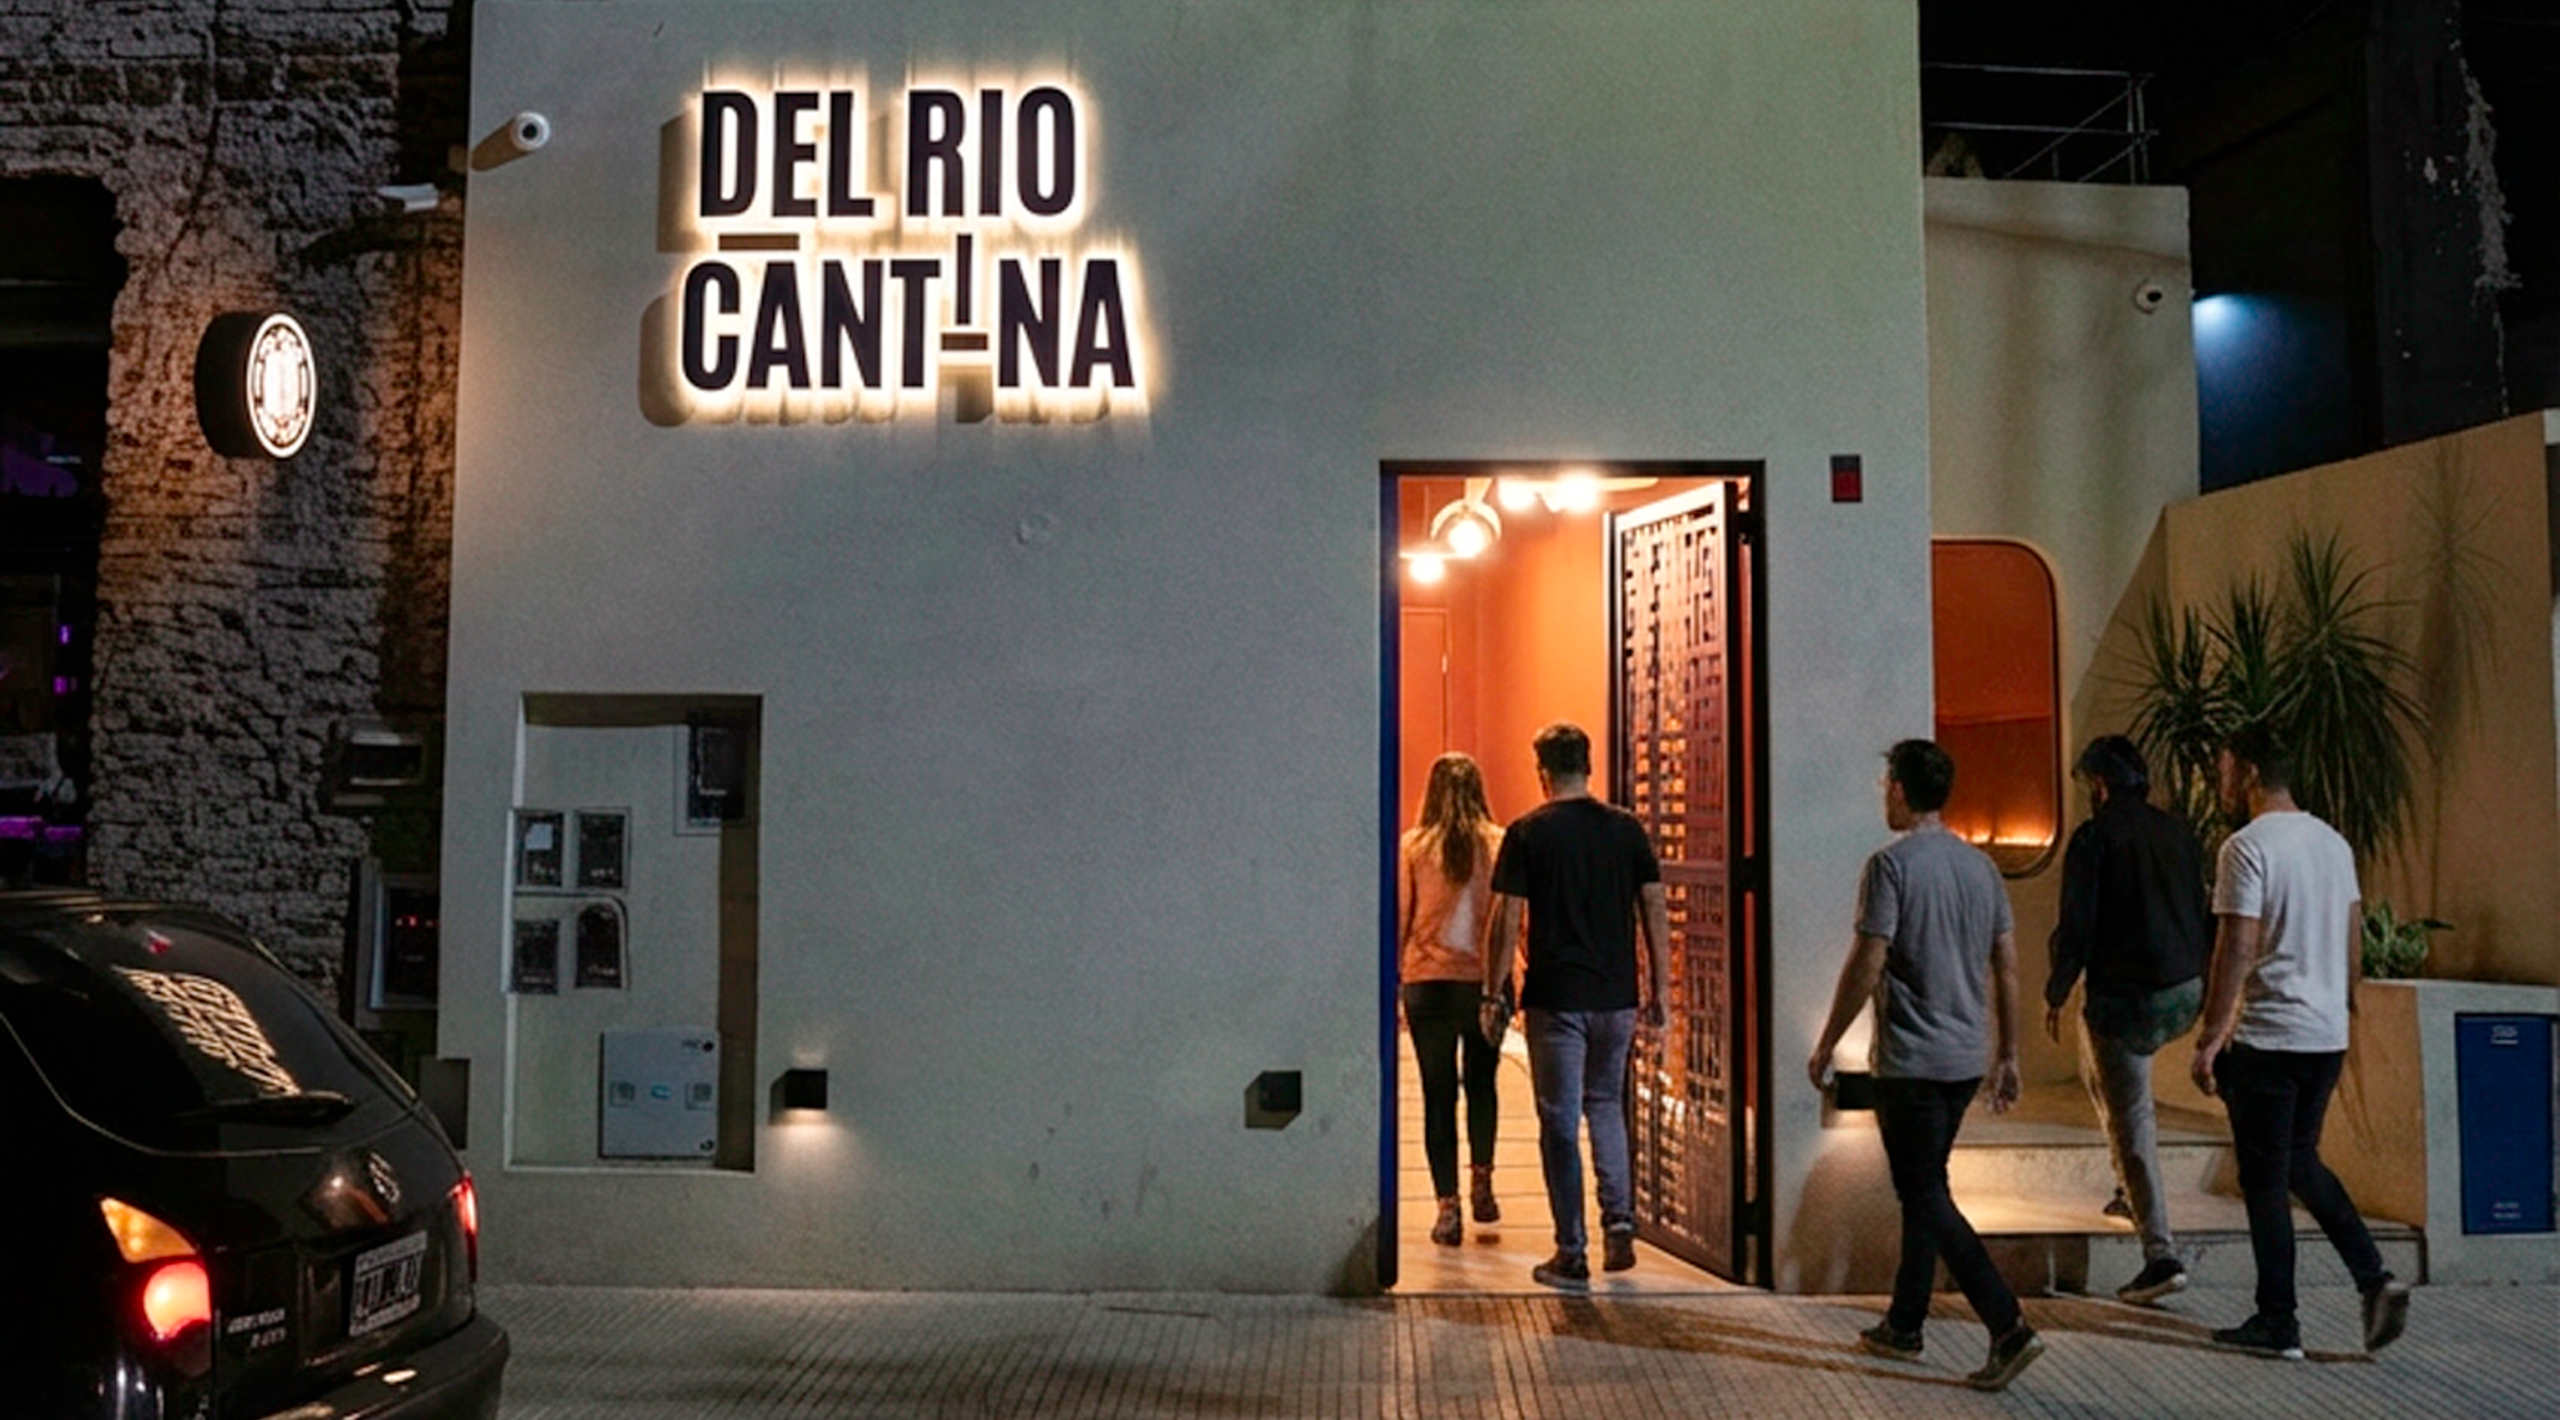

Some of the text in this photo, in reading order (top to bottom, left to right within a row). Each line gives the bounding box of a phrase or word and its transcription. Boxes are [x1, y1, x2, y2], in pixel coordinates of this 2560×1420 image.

[700, 86, 1076, 217] DEL RIO
[682, 233, 1135, 391] CANTINA
